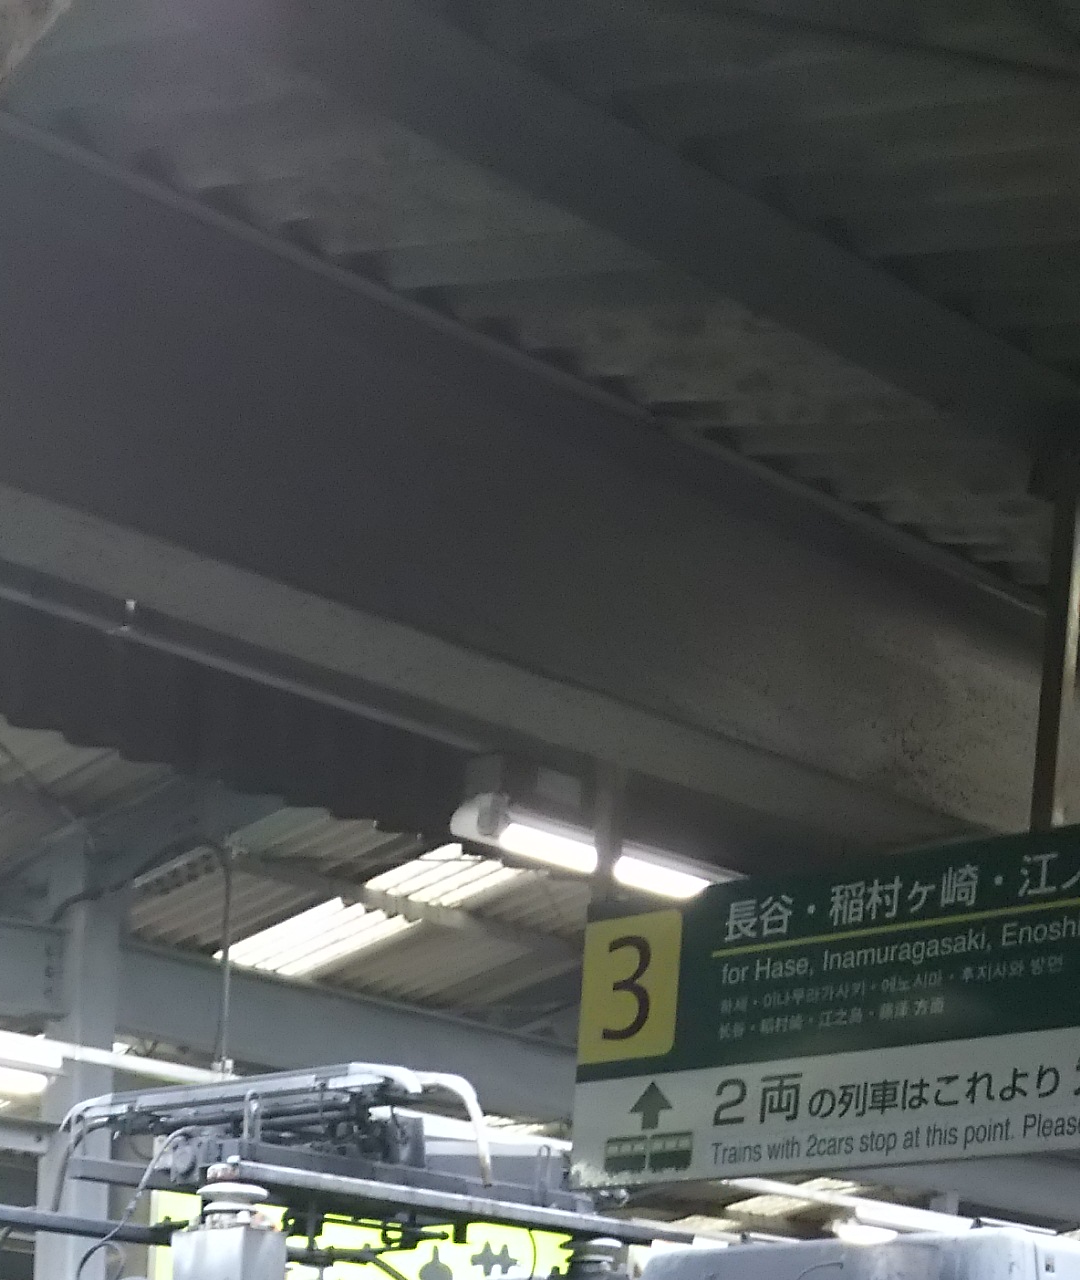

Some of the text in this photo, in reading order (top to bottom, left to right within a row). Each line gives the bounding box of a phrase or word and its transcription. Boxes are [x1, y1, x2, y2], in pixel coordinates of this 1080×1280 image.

[602, 935, 652, 1041] 3
[721, 963, 749, 985] for
[755, 957, 813, 981] Hase,
[823, 928, 992, 971] Inamuragasaki,
[712, 1056, 1080, 1127] 2両の列車はこれより
[711, 1141, 762, 1166] Trains
[768, 1136, 801, 1161] with
[806, 1133, 854, 1158] 2cars
[860, 1128, 898, 1157] stop
[903, 1126, 922, 1150] at
[926, 1121, 958, 1148] this
[1022, 1112, 1080, 1140] Pleas
